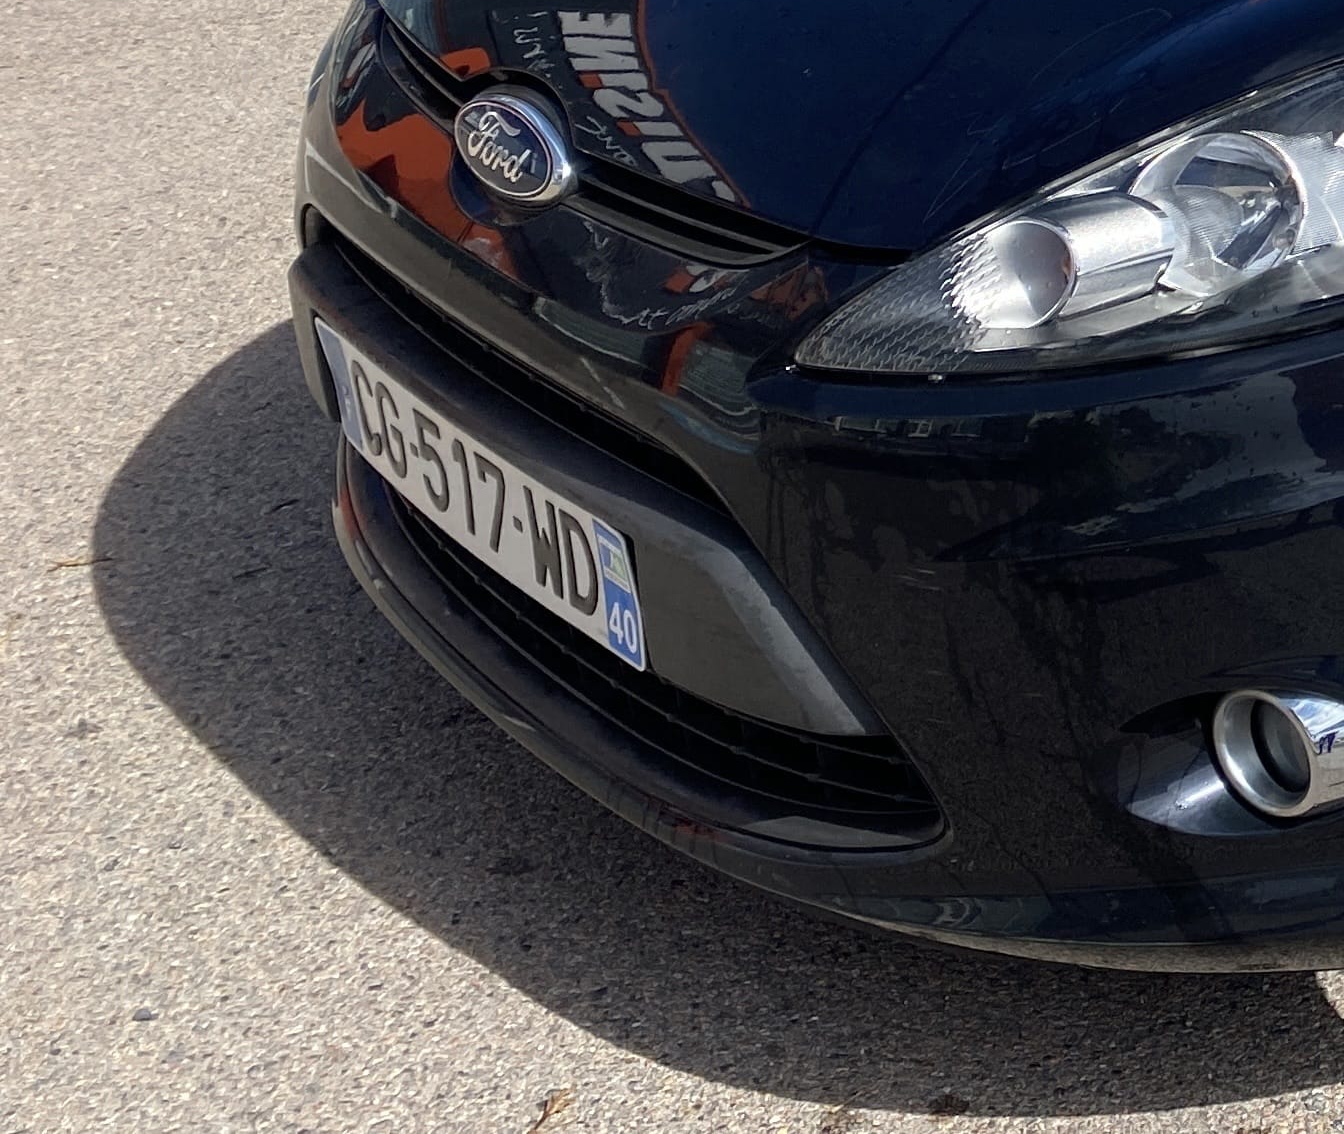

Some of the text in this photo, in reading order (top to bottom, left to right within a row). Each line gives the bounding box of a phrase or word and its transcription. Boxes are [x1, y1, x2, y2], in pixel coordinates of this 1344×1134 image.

[467, 111, 531, 183] Ford
[351, 359, 599, 617] CG-517-WD
[609, 602, 638, 655] 40
